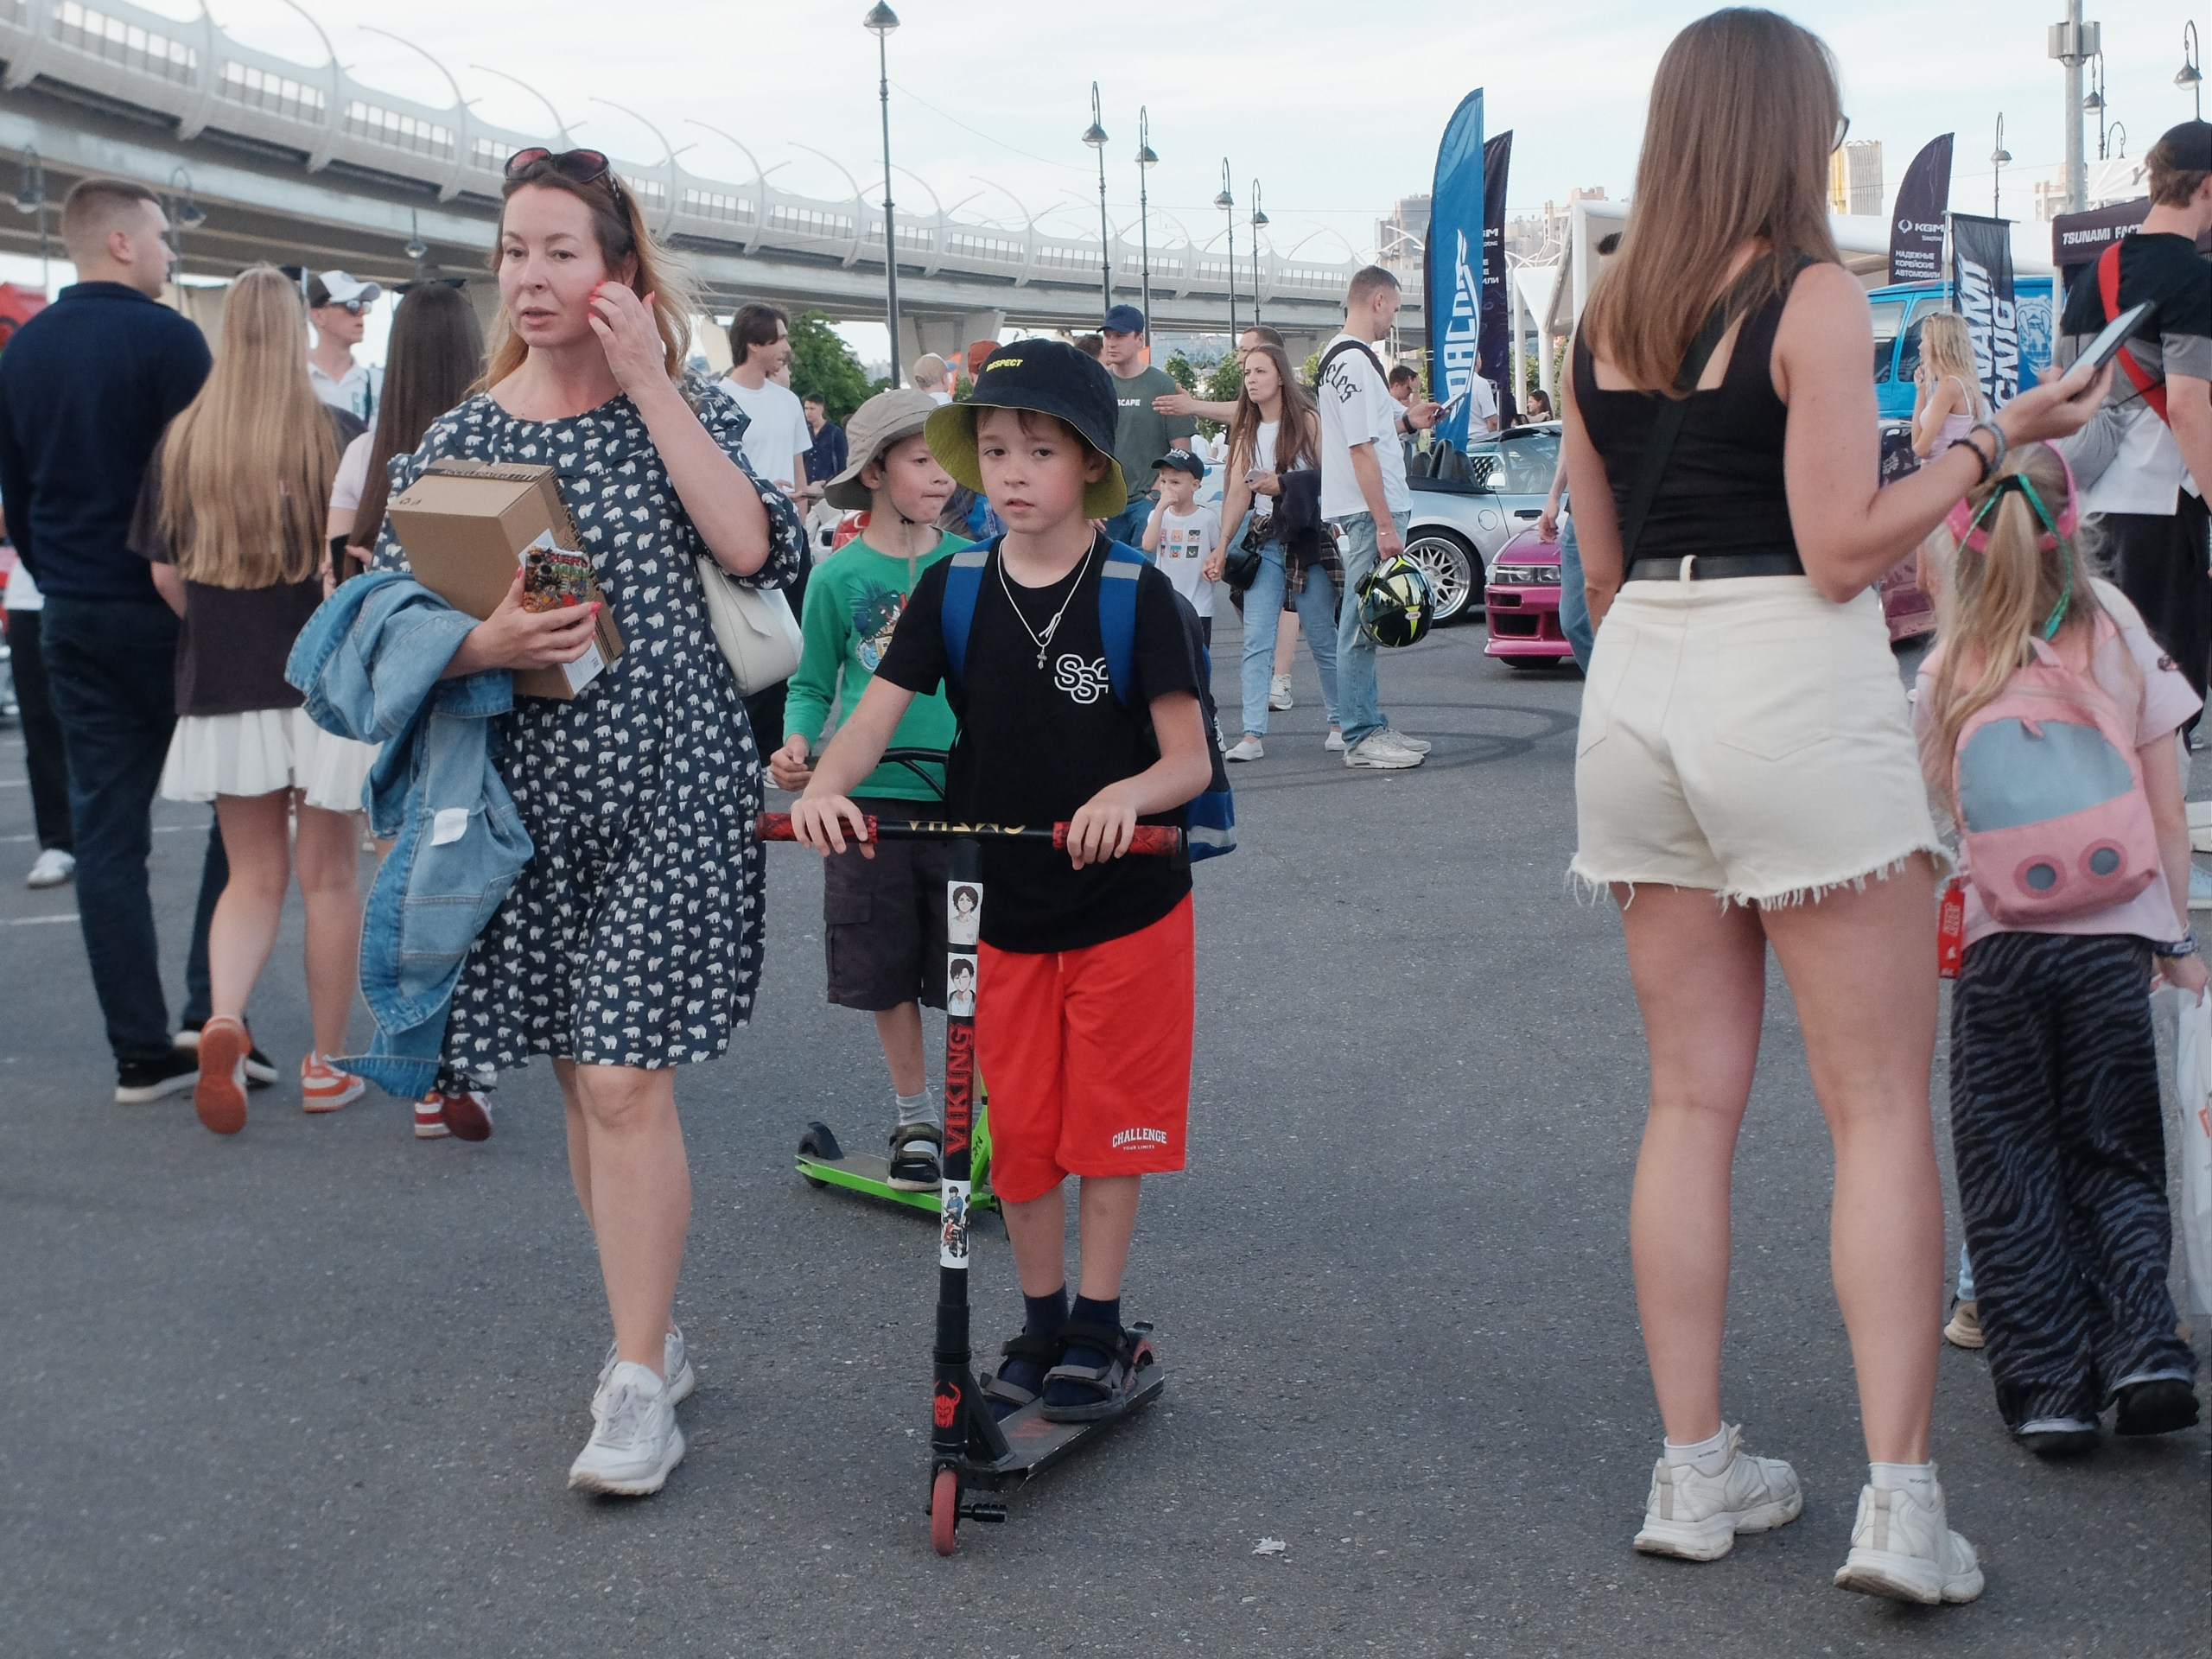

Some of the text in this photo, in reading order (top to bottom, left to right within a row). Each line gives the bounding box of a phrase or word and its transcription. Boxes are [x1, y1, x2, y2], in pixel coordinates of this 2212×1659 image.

[1915, 223, 1945, 232] KGM
[2063, 228, 2111, 245] TSUNAMI
[1895, 250, 1935, 260] НАДЕЖНЫЕ
[1895, 259, 1935, 270] КОРЕЙСКИЕ
[1895, 269, 1941, 279] АВТОМОБИЛИ
[986, 359, 1024, 372] RESPECT
[946, 1023, 973, 1156] VIKING
[1112, 1128, 1167, 1148] CHALLENGE
